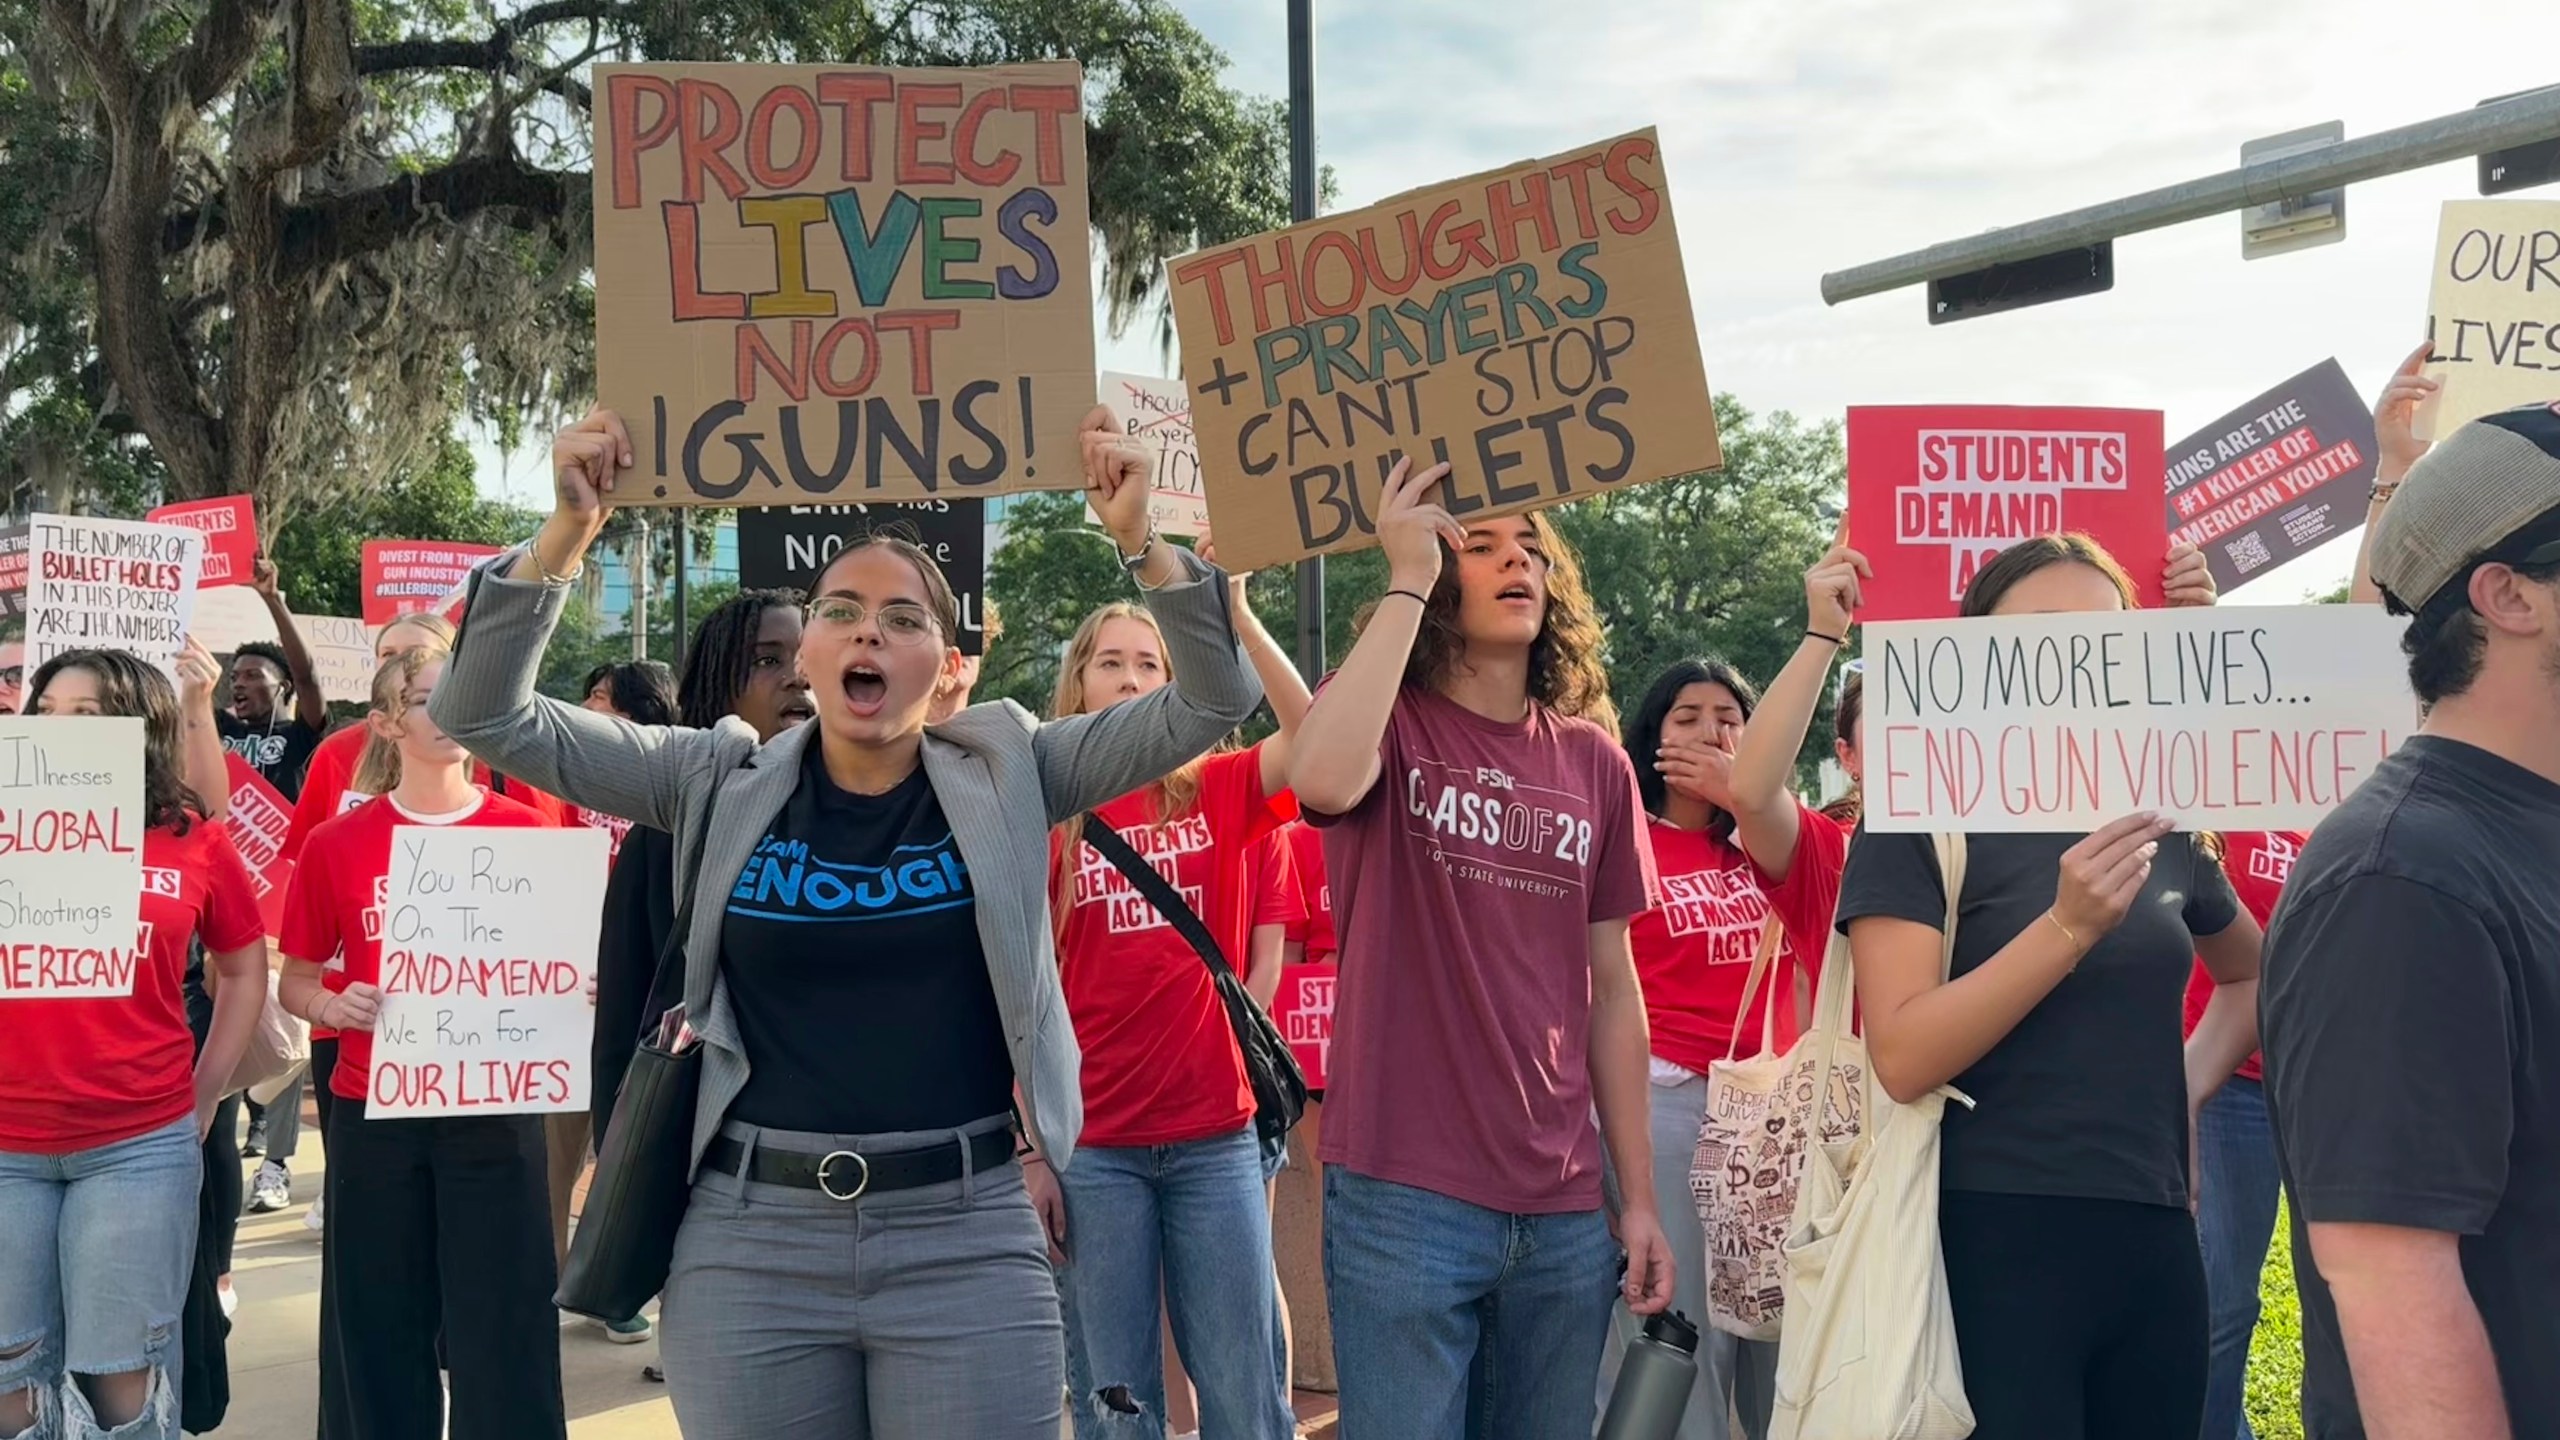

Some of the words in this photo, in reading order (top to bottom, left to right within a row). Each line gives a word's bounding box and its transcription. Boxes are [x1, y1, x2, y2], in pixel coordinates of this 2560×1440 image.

[606, 71, 1081, 209] PROTECT
[661, 187, 1060, 322] LIVES
[1176, 137, 1660, 346] THOUGHTS
[2450, 229, 2560, 292] OUR
[1253, 241, 1608, 409] PRAYERS
[735, 309, 961, 403] NOT
[1475, 315, 1635, 417] STOP
[2214, 423, 2261, 462] ARE
[2256, 398, 2307, 436] THE
[1922, 434, 2124, 484] STUDENTS
[2178, 486, 2208, 516] #1
[2204, 446, 2284, 500] KILLER
[2280, 428, 2312, 460] OF
[1900, 491, 2058, 538] DEMAND
[2168, 482, 2284, 549] AMERICAN
[2278, 442, 2360, 496] YOUTH
[36, 524, 88, 554] THE
[91, 529, 161, 562] NUMBER
[165, 536, 195, 563] OF
[378, 550, 417, 564] DIVEST
[420, 551, 454, 565] FROM
[42, 551, 117, 582] BULLET
[119, 559, 182, 592] HOLES
[383, 566, 407, 580] GUN
[43, 582, 64, 604] IN
[70, 585, 114, 607] THIS
[116, 586, 180, 616] POSTER
[36, 607, 77, 635] ARE
[78, 611, 113, 638] THE
[115, 613, 183, 643] NUMBER
[1885, 634, 1964, 717] NO
[1982, 632, 2131, 710] MORE
[2143, 628, 2312, 706] LIVES...
[2, 736, 113, 788] Illnesses
[1476, 766, 1515, 790] FSU
[1886, 725, 1984, 818] END
[2000, 724, 2100, 816] GUN
[1503, 801, 1554, 855] OF
[1554, 812, 1592, 867] 28
[404, 838, 455, 896] You
[470, 846, 533, 895] Run
[1459, 865, 1494, 884] STATE
[1497, 874, 1569, 900] UNIVERSITY
[391, 904, 434, 943] On
[446, 906, 504, 943] The
[1665, 893, 1763, 934] DEMAND
[385, 950, 453, 996] 2ND
[380, 1010, 418, 1046] We
[436, 1009, 482, 1046] Run
[497, 1008, 538, 1043] For
[374, 1061, 448, 1108] OUR
